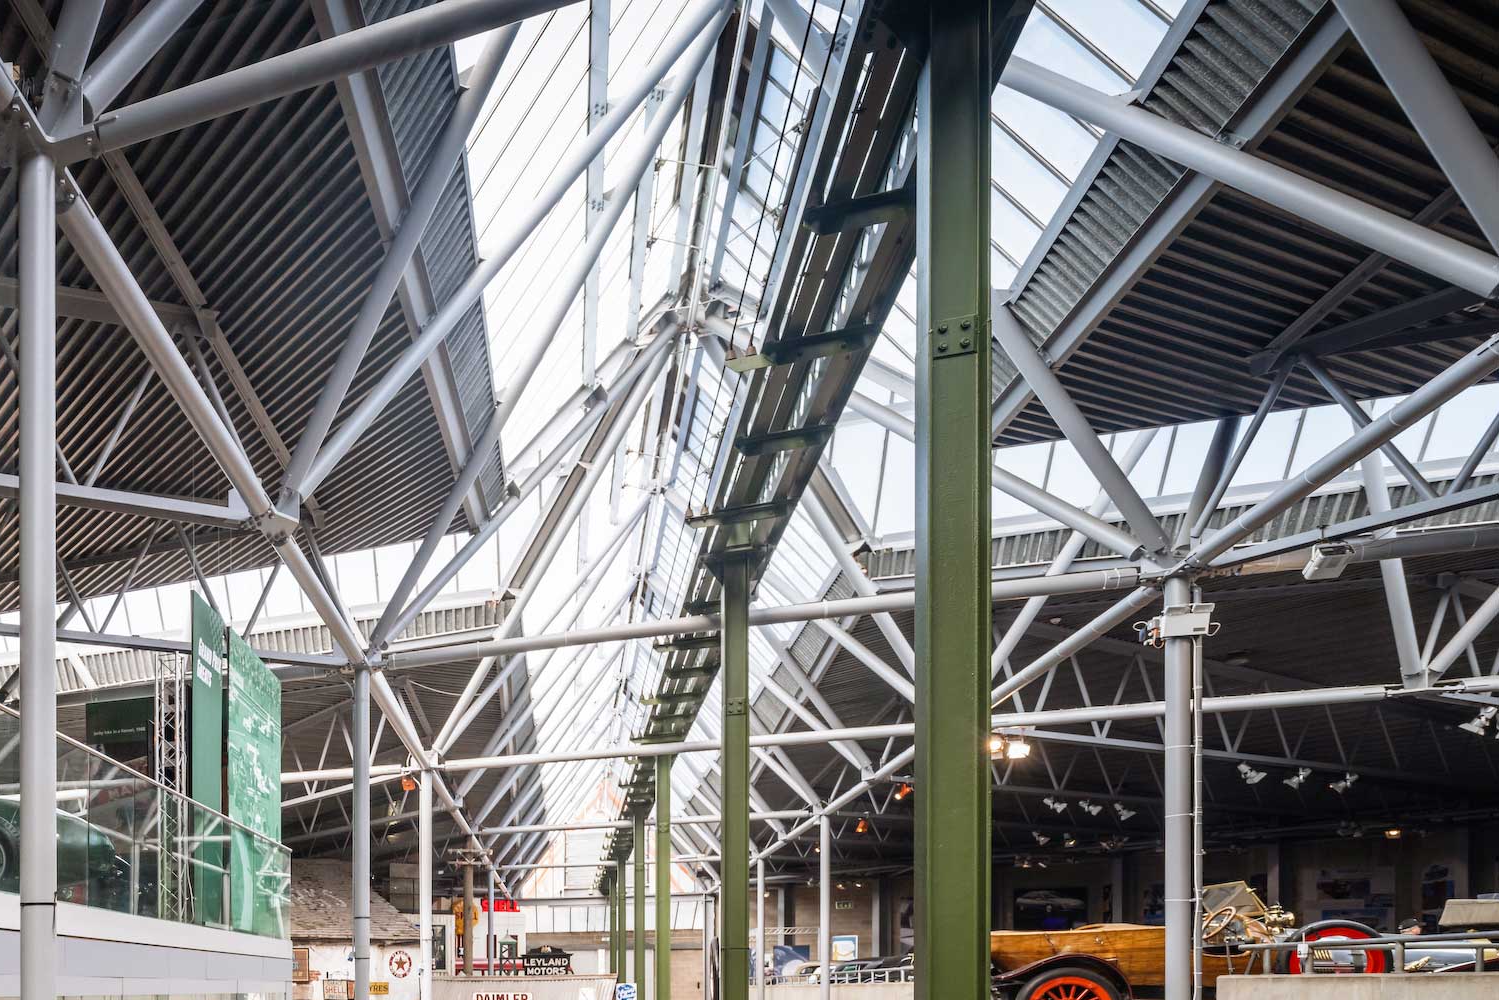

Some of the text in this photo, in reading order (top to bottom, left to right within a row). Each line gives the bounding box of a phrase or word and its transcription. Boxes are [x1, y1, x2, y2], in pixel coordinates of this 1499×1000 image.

[524, 958, 568, 967] LEYLAND
[527, 967, 566, 975] MOTORS
[325, 985, 346, 994] SHELL
[369, 984, 388, 993] YRES
